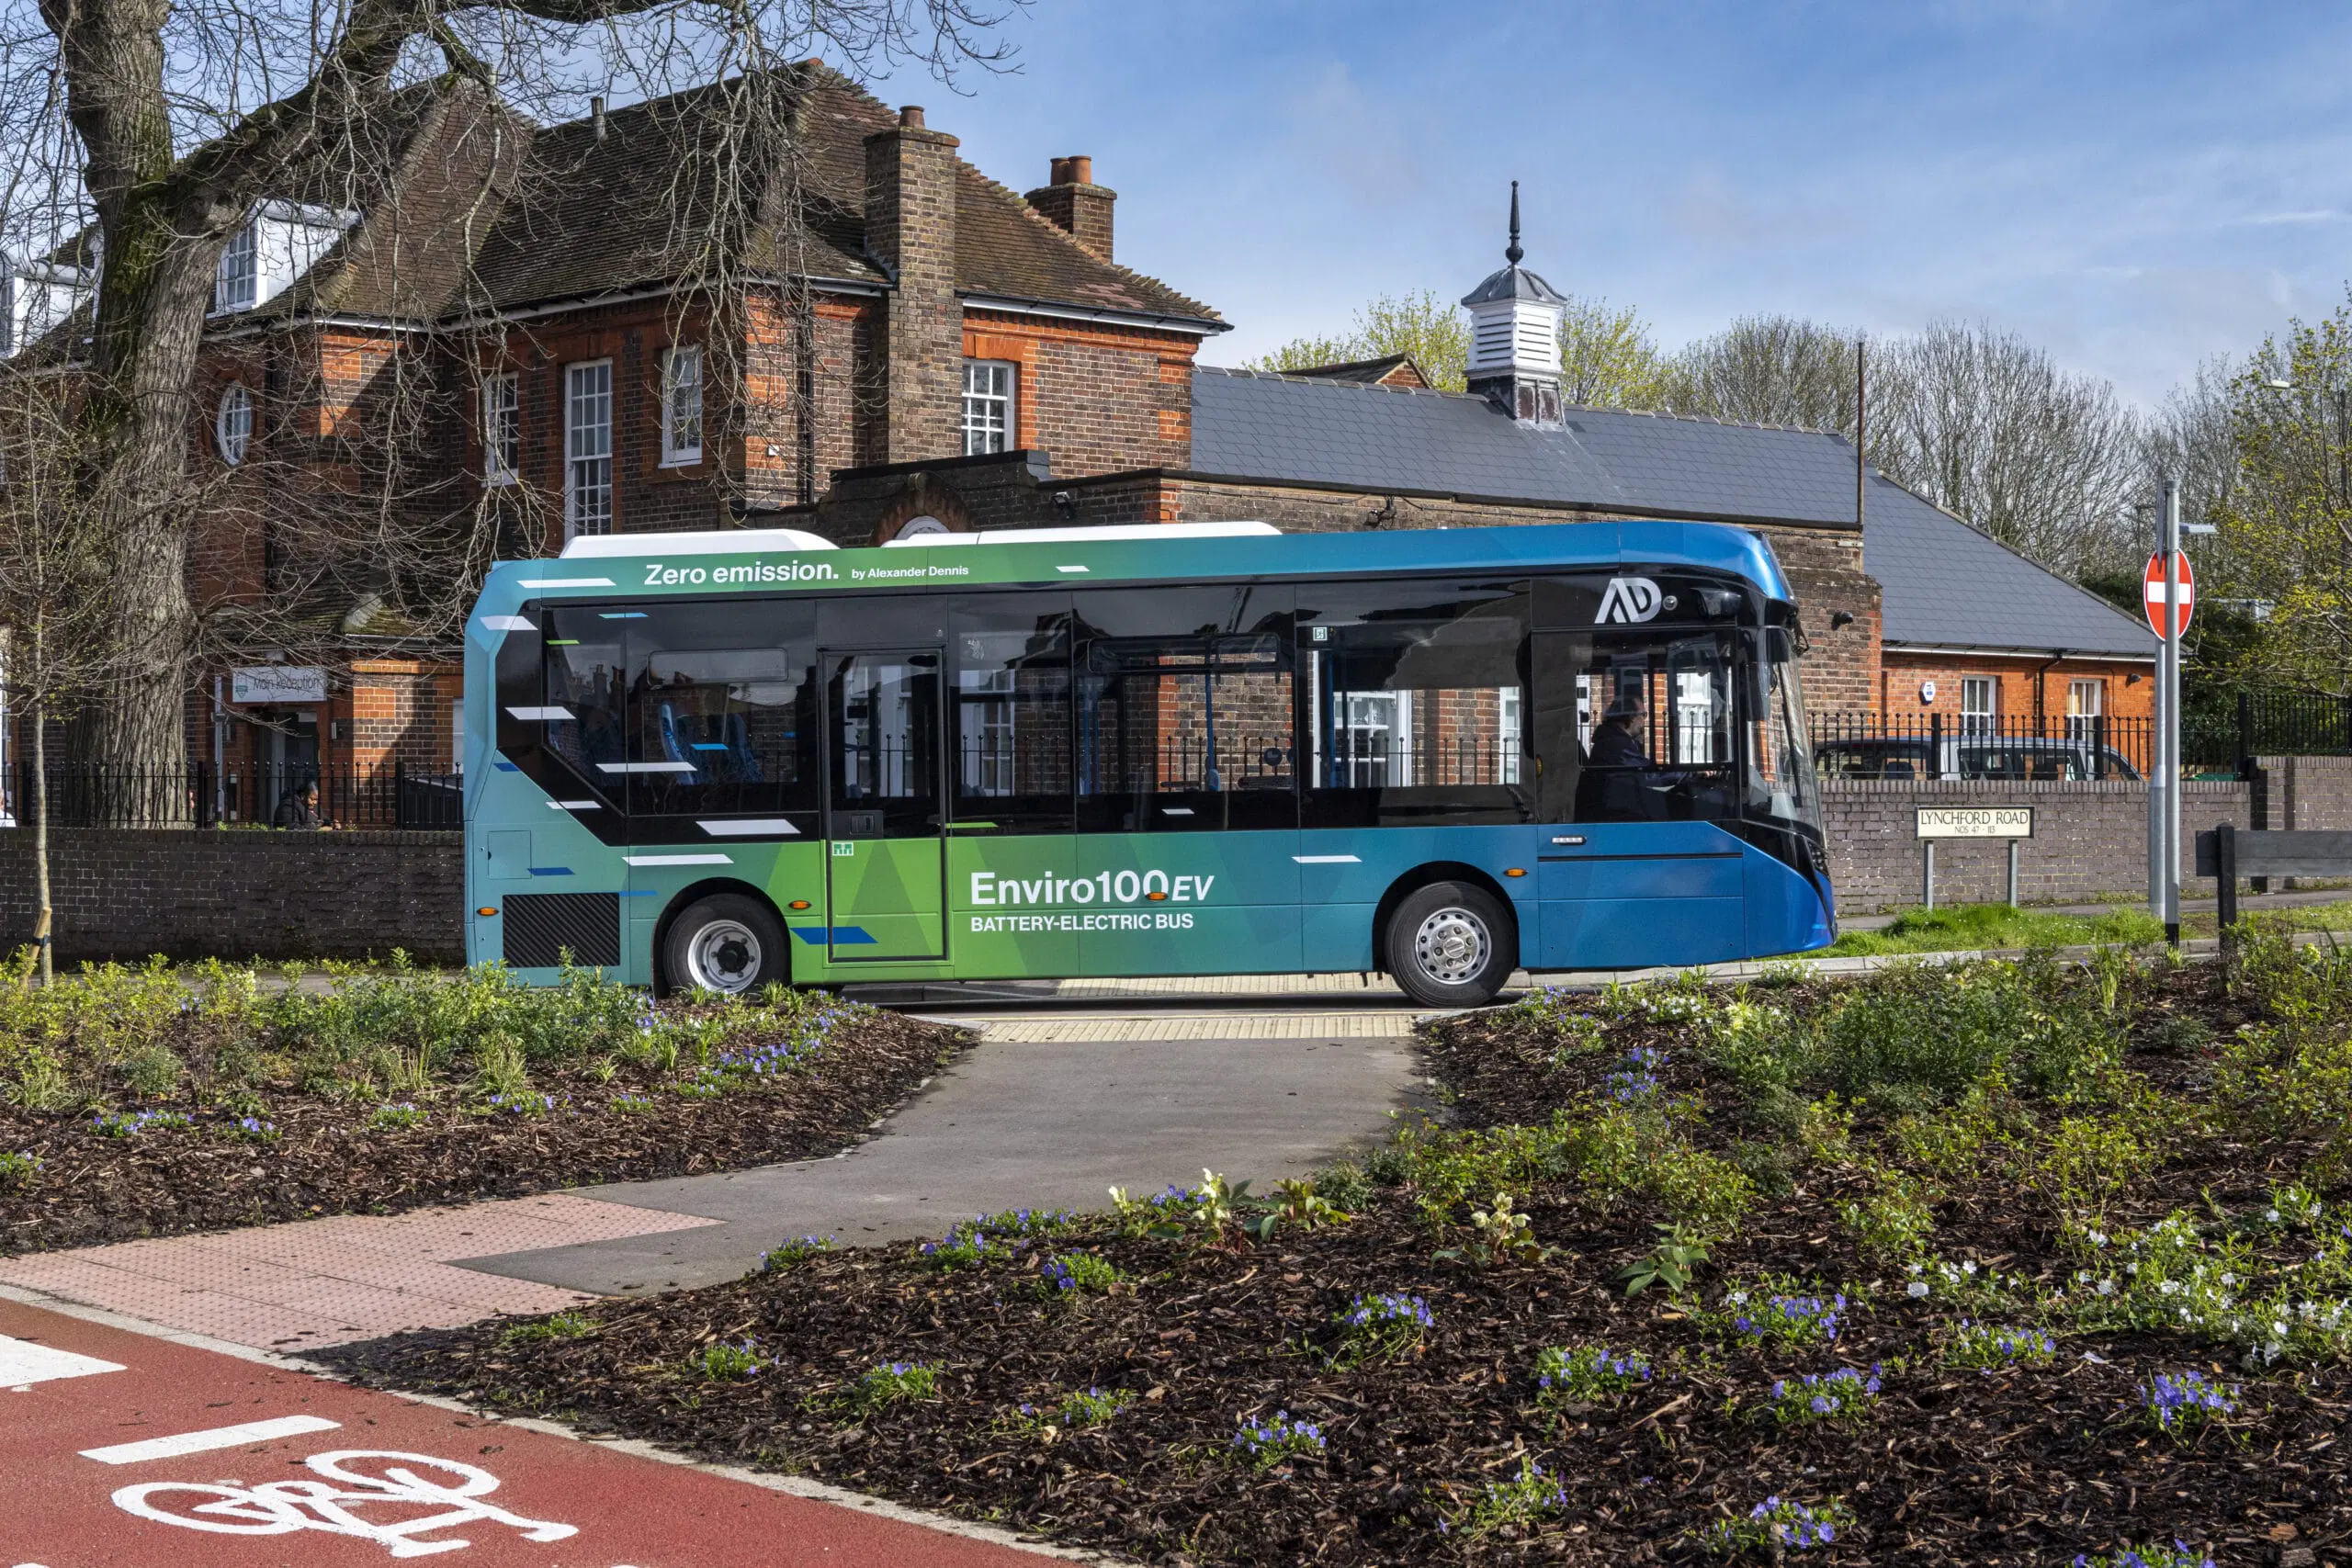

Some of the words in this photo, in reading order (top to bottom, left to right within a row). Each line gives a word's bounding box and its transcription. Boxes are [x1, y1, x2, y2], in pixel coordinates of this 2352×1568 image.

[644, 564, 707, 585] Zero
[712, 559, 839, 583] emission.
[852, 569, 865, 581] by
[867, 567, 926, 579] Alexander
[928, 565, 969, 577] Dennis
[1594, 577, 1662, 624] AD
[1921, 811, 1991, 825] LYNCHFORD
[1996, 811, 2029, 825] ROAD
[1955, 826, 1969, 834] NOS
[1972, 826, 1980, 834] 47
[1987, 826, 1996, 834] 113
[971, 915, 1152, 931] BATTERY-ELECTRIC
[1155, 913, 1194, 929] BUS
